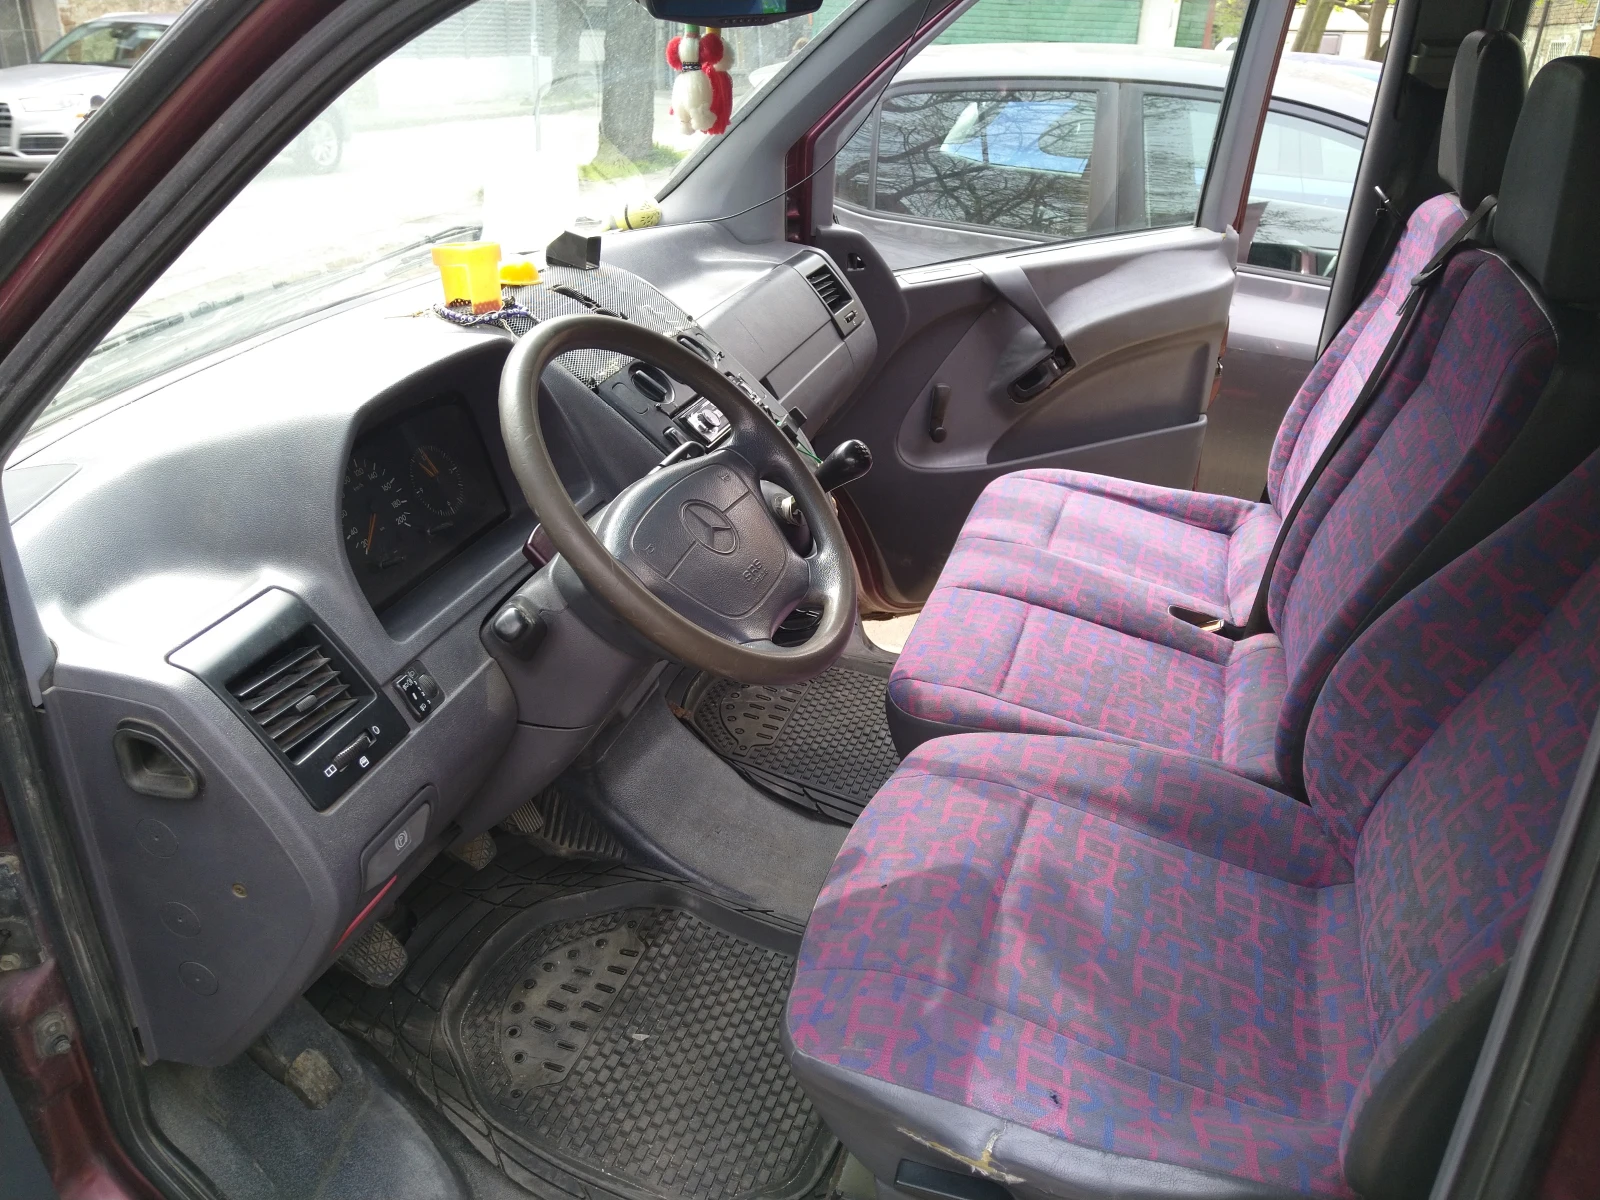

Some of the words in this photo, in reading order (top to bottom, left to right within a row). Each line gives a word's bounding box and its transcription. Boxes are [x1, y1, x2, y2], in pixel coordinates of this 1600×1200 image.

[354, 467, 364, 477] 120
[367, 471, 378, 481] 140
[381, 482, 392, 492] 160
[391, 499, 402, 509] 180
[395, 514, 407, 525] 200
[350, 526, 359, 536] 40
[742, 558, 763, 582] SRS
